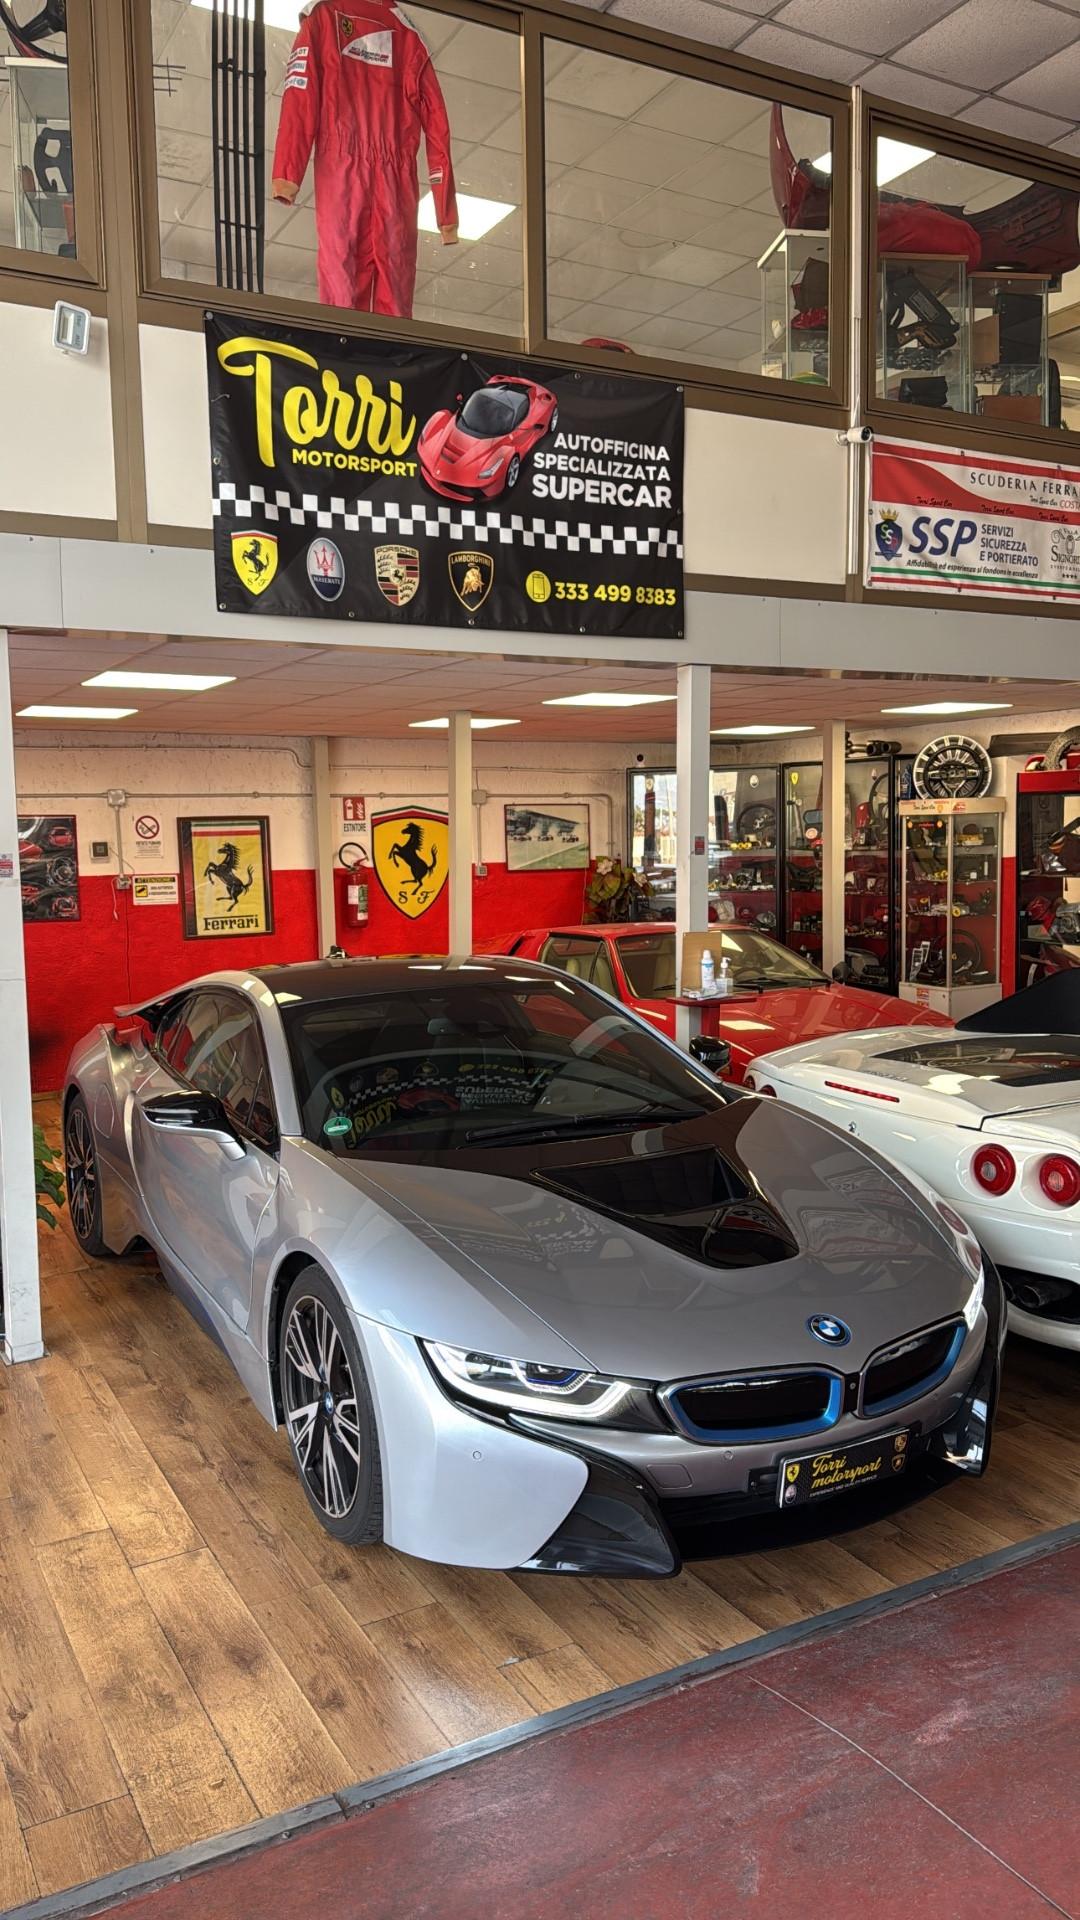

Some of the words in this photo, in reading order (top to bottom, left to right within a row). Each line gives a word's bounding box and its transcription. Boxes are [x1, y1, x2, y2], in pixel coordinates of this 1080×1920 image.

[217, 336, 417, 468] Torri
[554, 432, 671, 461] AUTOFFICINA
[292, 448, 417, 477] MOTORSPORT
[533, 452, 671, 481] SPECIALIZZATA
[532, 473, 672, 509] SUPERCAR
[970, 471, 1037, 491] SCUDERIA
[908, 516, 977, 557] SSP
[981, 524, 1014, 537] SERVIZI
[376, 546, 417, 557] PORSCHE
[980, 538, 1027, 552] SICUREZZA
[451, 555, 491, 567] LAMBORGHINI
[938, 561, 947, 570] ed
[979, 551, 986, 561] E
[987, 551, 1038, 566] PORTIERATO
[554, 581, 589, 601] 333
[593, 584, 632, 602] 499
[635, 586, 677, 606] 8383
[343, 823, 366, 833] ESTINTORE
[398, 890, 408, 904] S
[204, 914, 259, 931] Ferrari
[811, 1457, 882, 1489] motorsport
[812, 1453, 847, 1477] Torri
